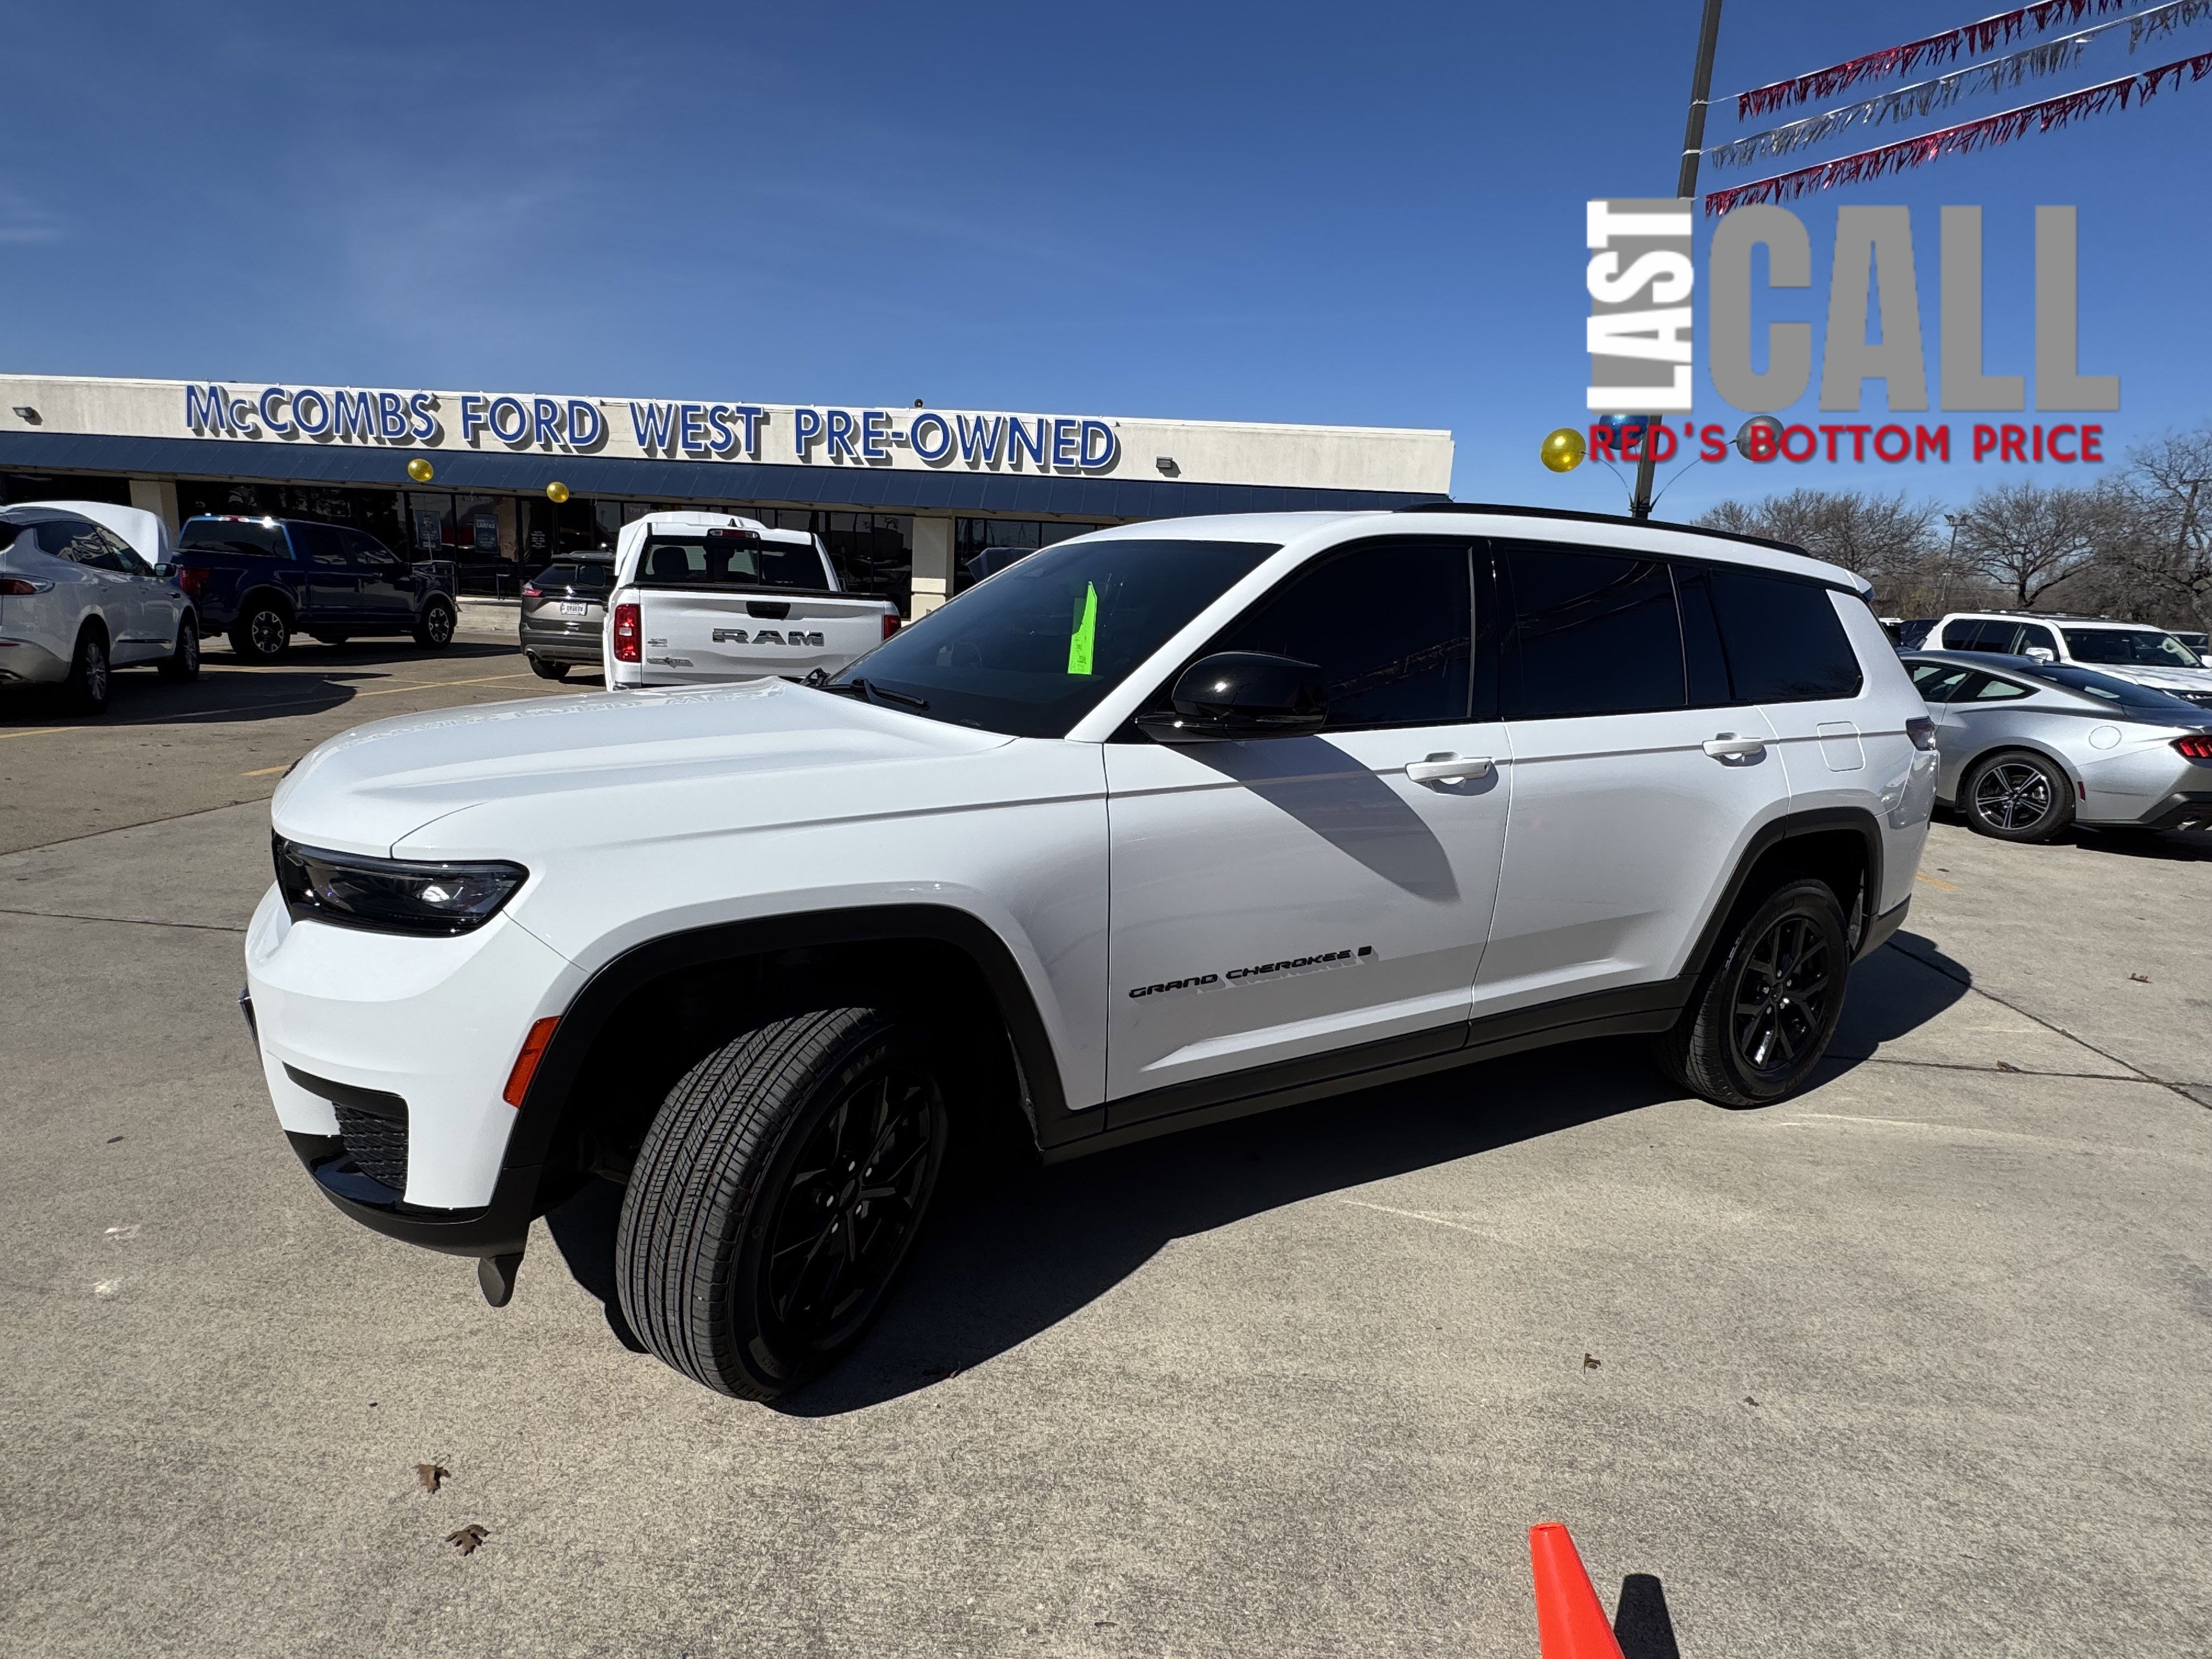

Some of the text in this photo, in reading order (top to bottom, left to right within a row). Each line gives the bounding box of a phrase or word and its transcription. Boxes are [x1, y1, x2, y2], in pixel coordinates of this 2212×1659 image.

[185, 384, 1116, 469] McCOMBS FORD WEST PRE-OWNED
[713, 628, 825, 646] RAM
[1128, 949, 1351, 998] GRAND CHEROKEE
